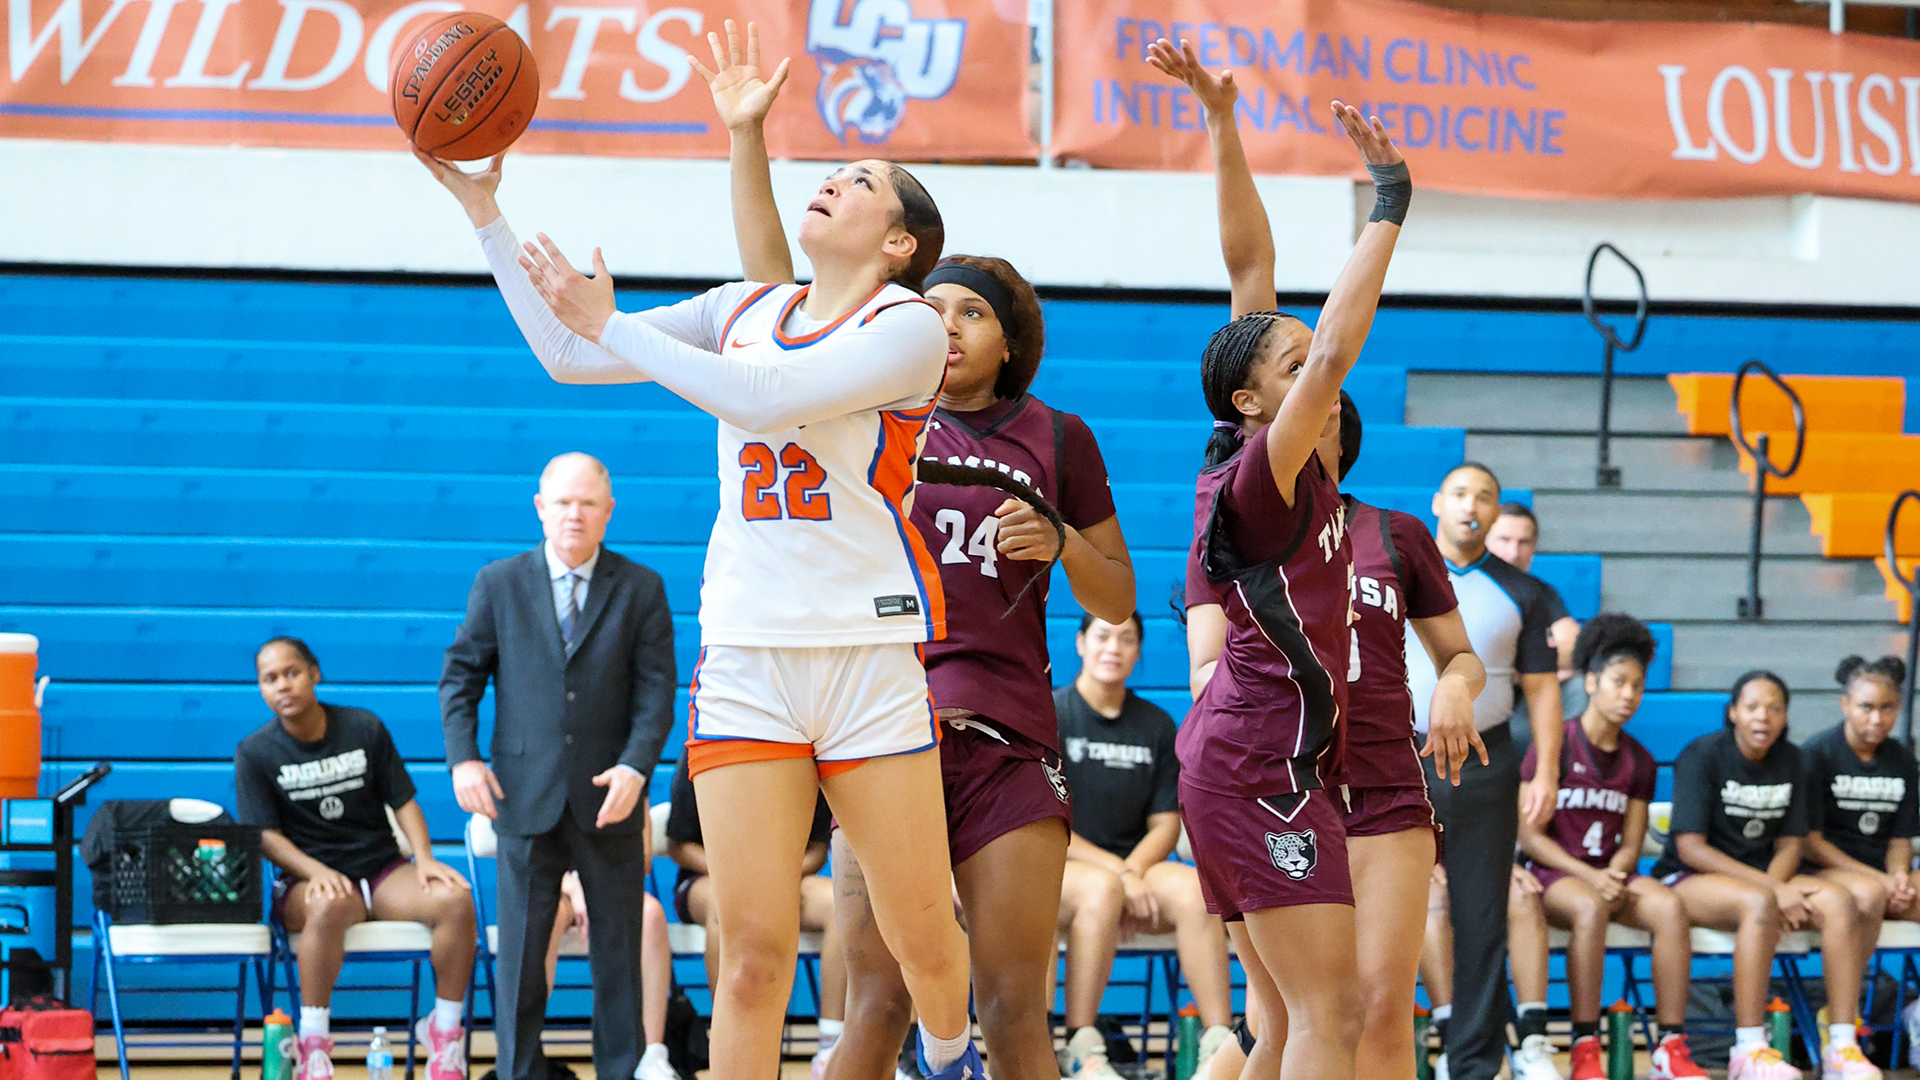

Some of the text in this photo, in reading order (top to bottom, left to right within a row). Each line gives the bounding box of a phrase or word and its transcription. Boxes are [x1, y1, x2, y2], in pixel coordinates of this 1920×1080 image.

[402, 20, 475, 106] SPALDING
[434, 47, 498, 123] LEGACY
[467, 65, 503, 110] 1000
[1383, 38, 1538, 91] CLINIC
[1093, 77, 1327, 134] INTENAL
[738, 442, 832, 522] 22
[935, 508, 999, 579] 24
[905, 599, 916, 609] M
[1582, 821, 1604, 857] 4
